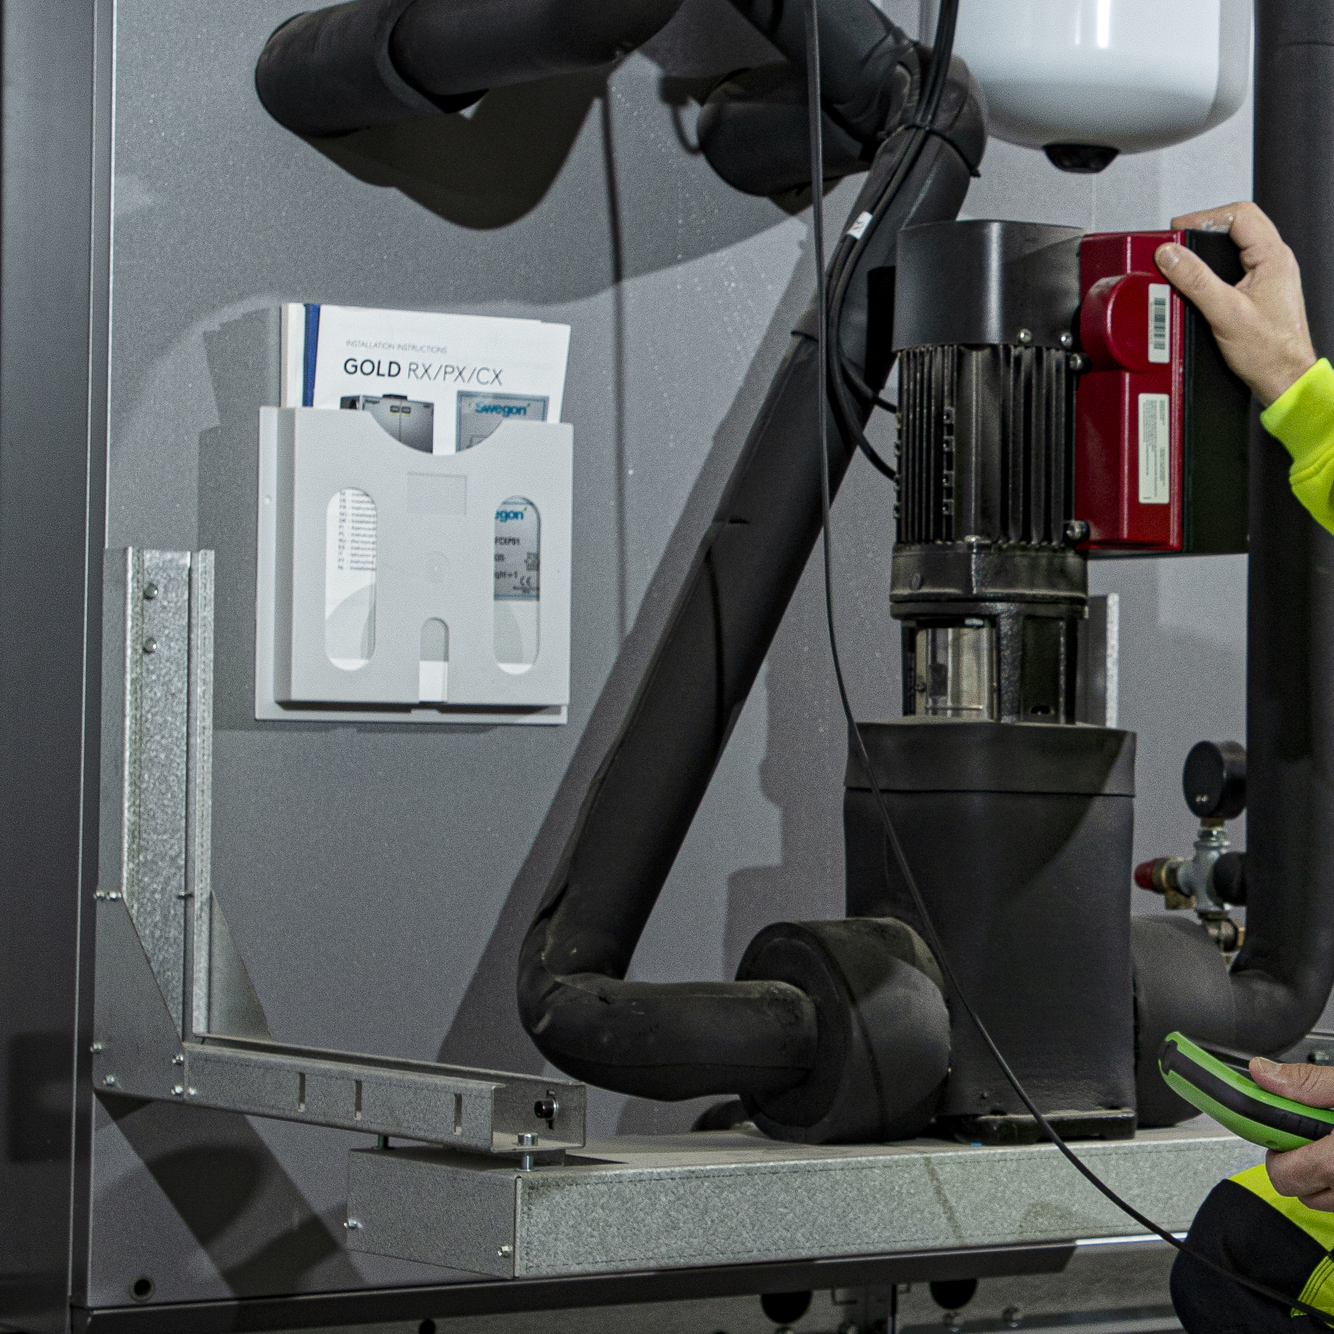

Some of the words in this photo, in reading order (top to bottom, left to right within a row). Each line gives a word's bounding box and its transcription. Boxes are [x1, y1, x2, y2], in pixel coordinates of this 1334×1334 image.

[345, 339, 395, 351] INSTALLATION
[397, 343, 447, 355] INSTRUCTIONS
[343, 357, 402, 378] GOLD
[407, 361, 503, 386] RX/PX/CX
[474, 400, 528, 417] Swegon
